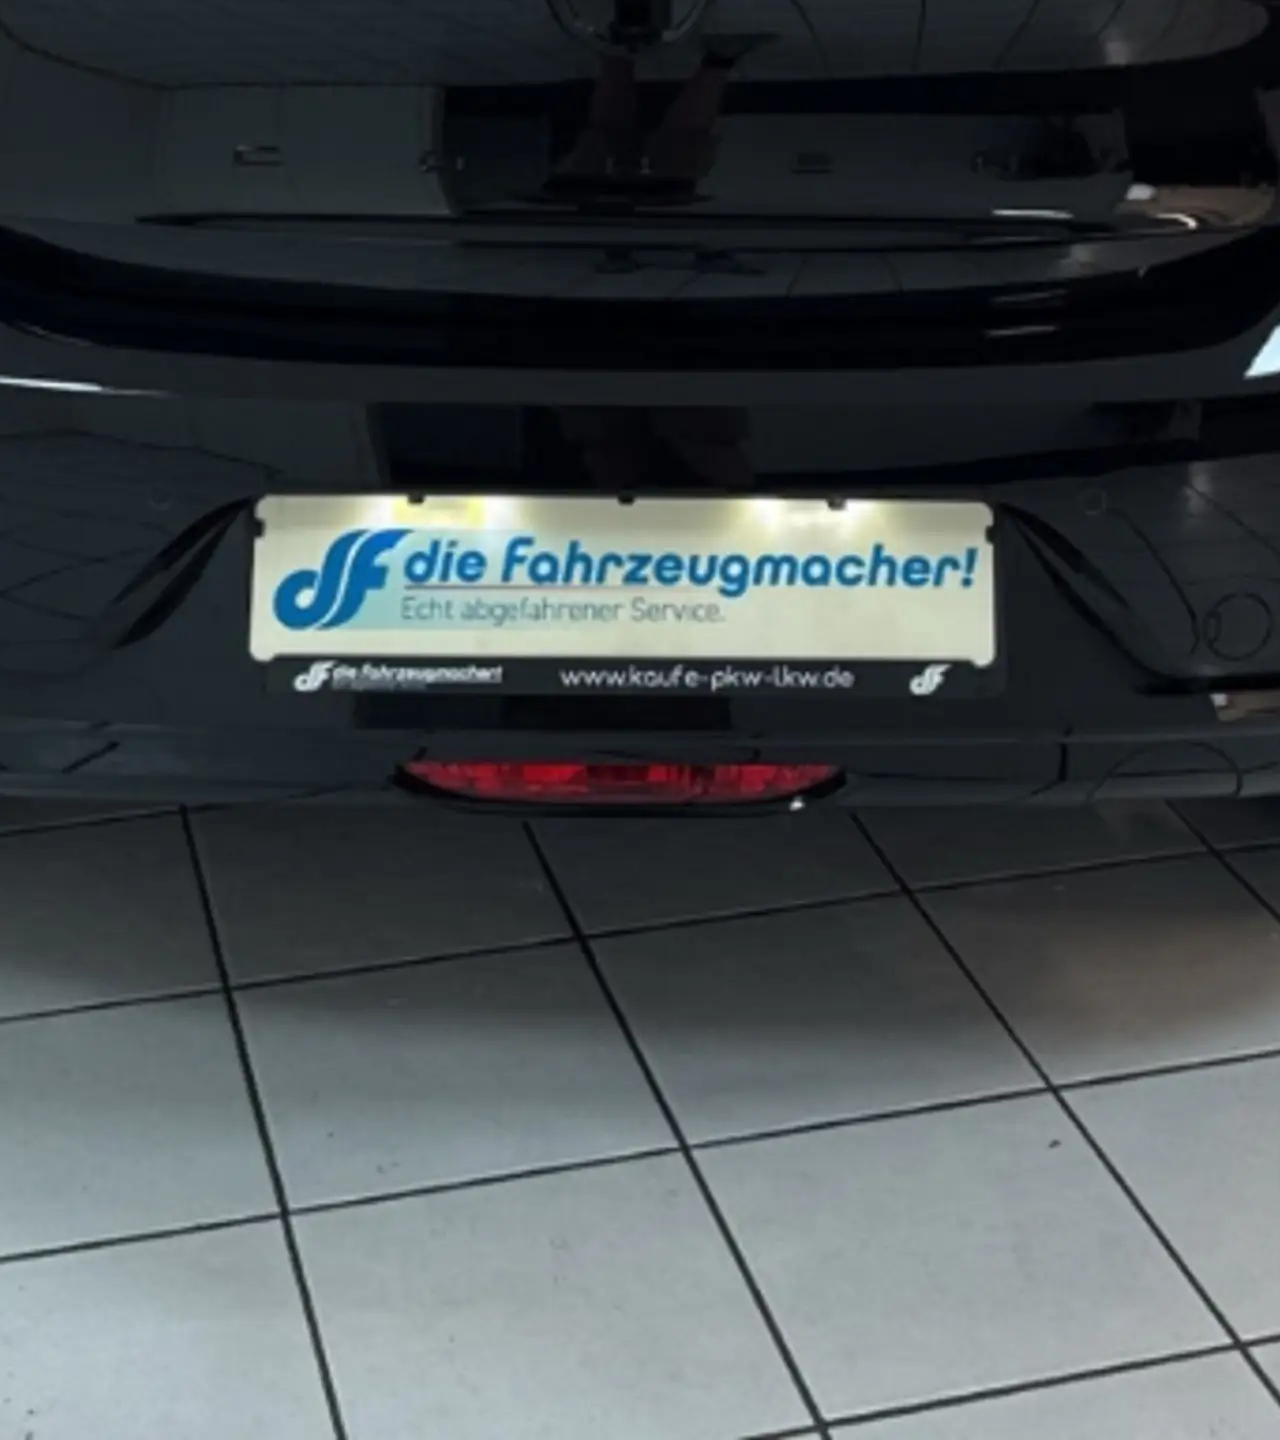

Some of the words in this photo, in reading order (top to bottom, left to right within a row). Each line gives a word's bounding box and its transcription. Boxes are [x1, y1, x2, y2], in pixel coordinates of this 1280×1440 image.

[403, 538, 488, 584] die
[500, 536, 979, 598] Fahrzeugmacher!
[400, 596, 456, 621] Echt
[460, 596, 624, 627] abgefahrener
[630, 596, 727, 624] Service.
[558, 664, 856, 692] www.kaufe-pkw-lkw.de
